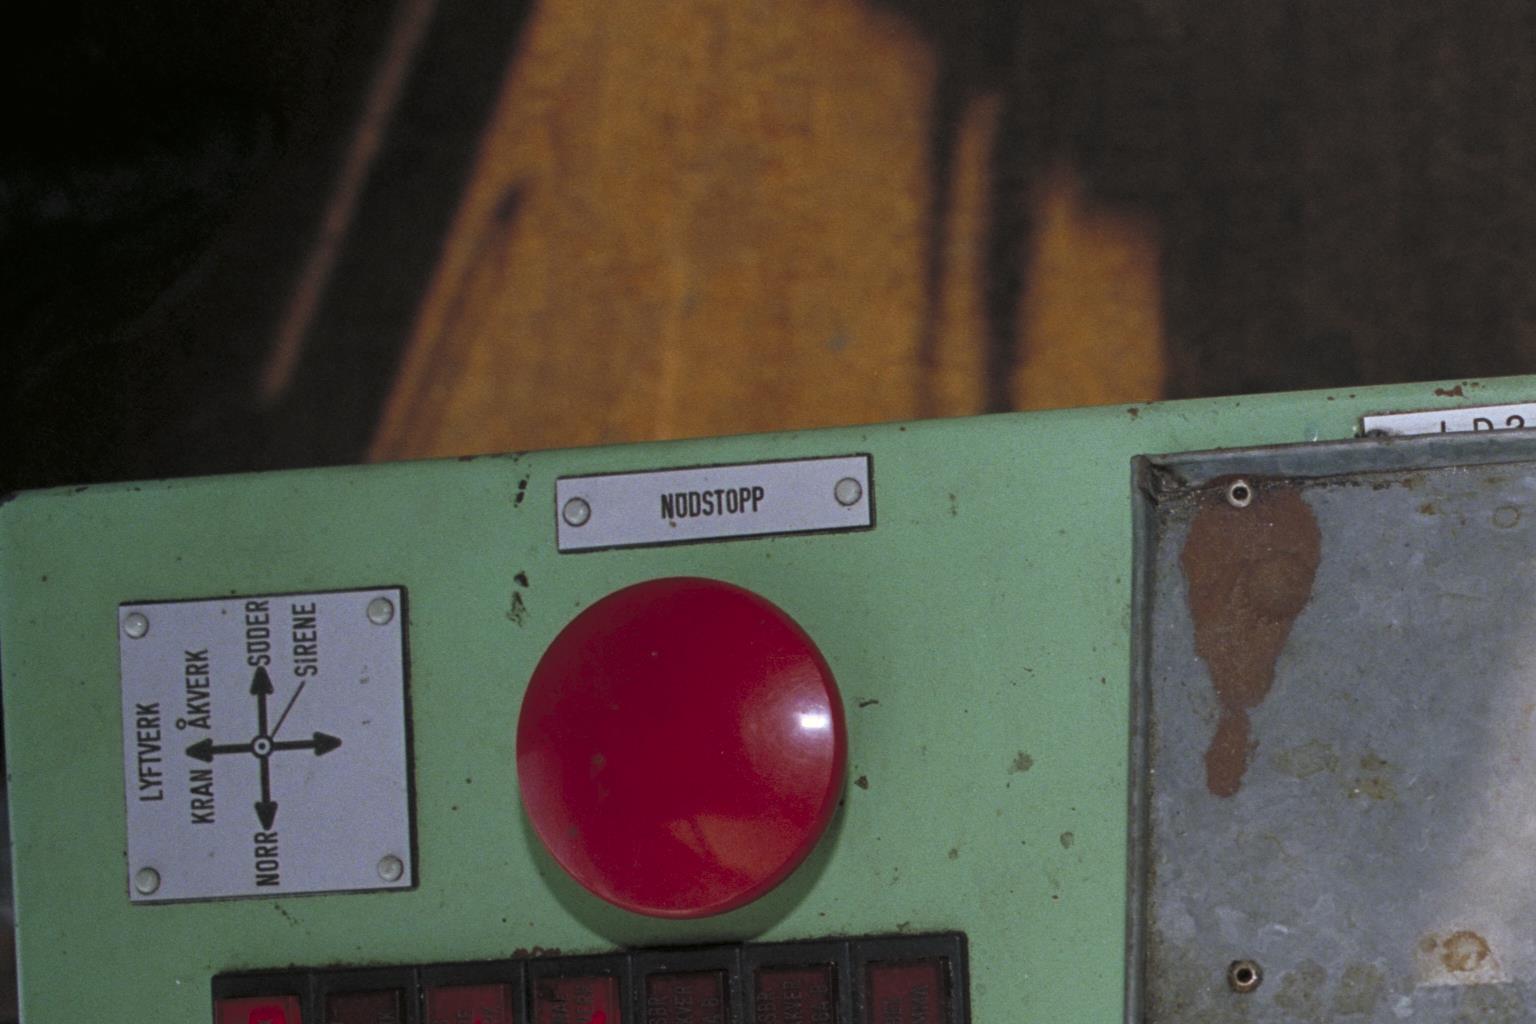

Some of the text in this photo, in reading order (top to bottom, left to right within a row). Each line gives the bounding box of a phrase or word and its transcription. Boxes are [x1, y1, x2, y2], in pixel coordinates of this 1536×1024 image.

[135, 702, 164, 802] LYFTVERK
[175, 648, 215, 825] KRAN ÅKVERK
[254, 831, 280, 887] NORR
